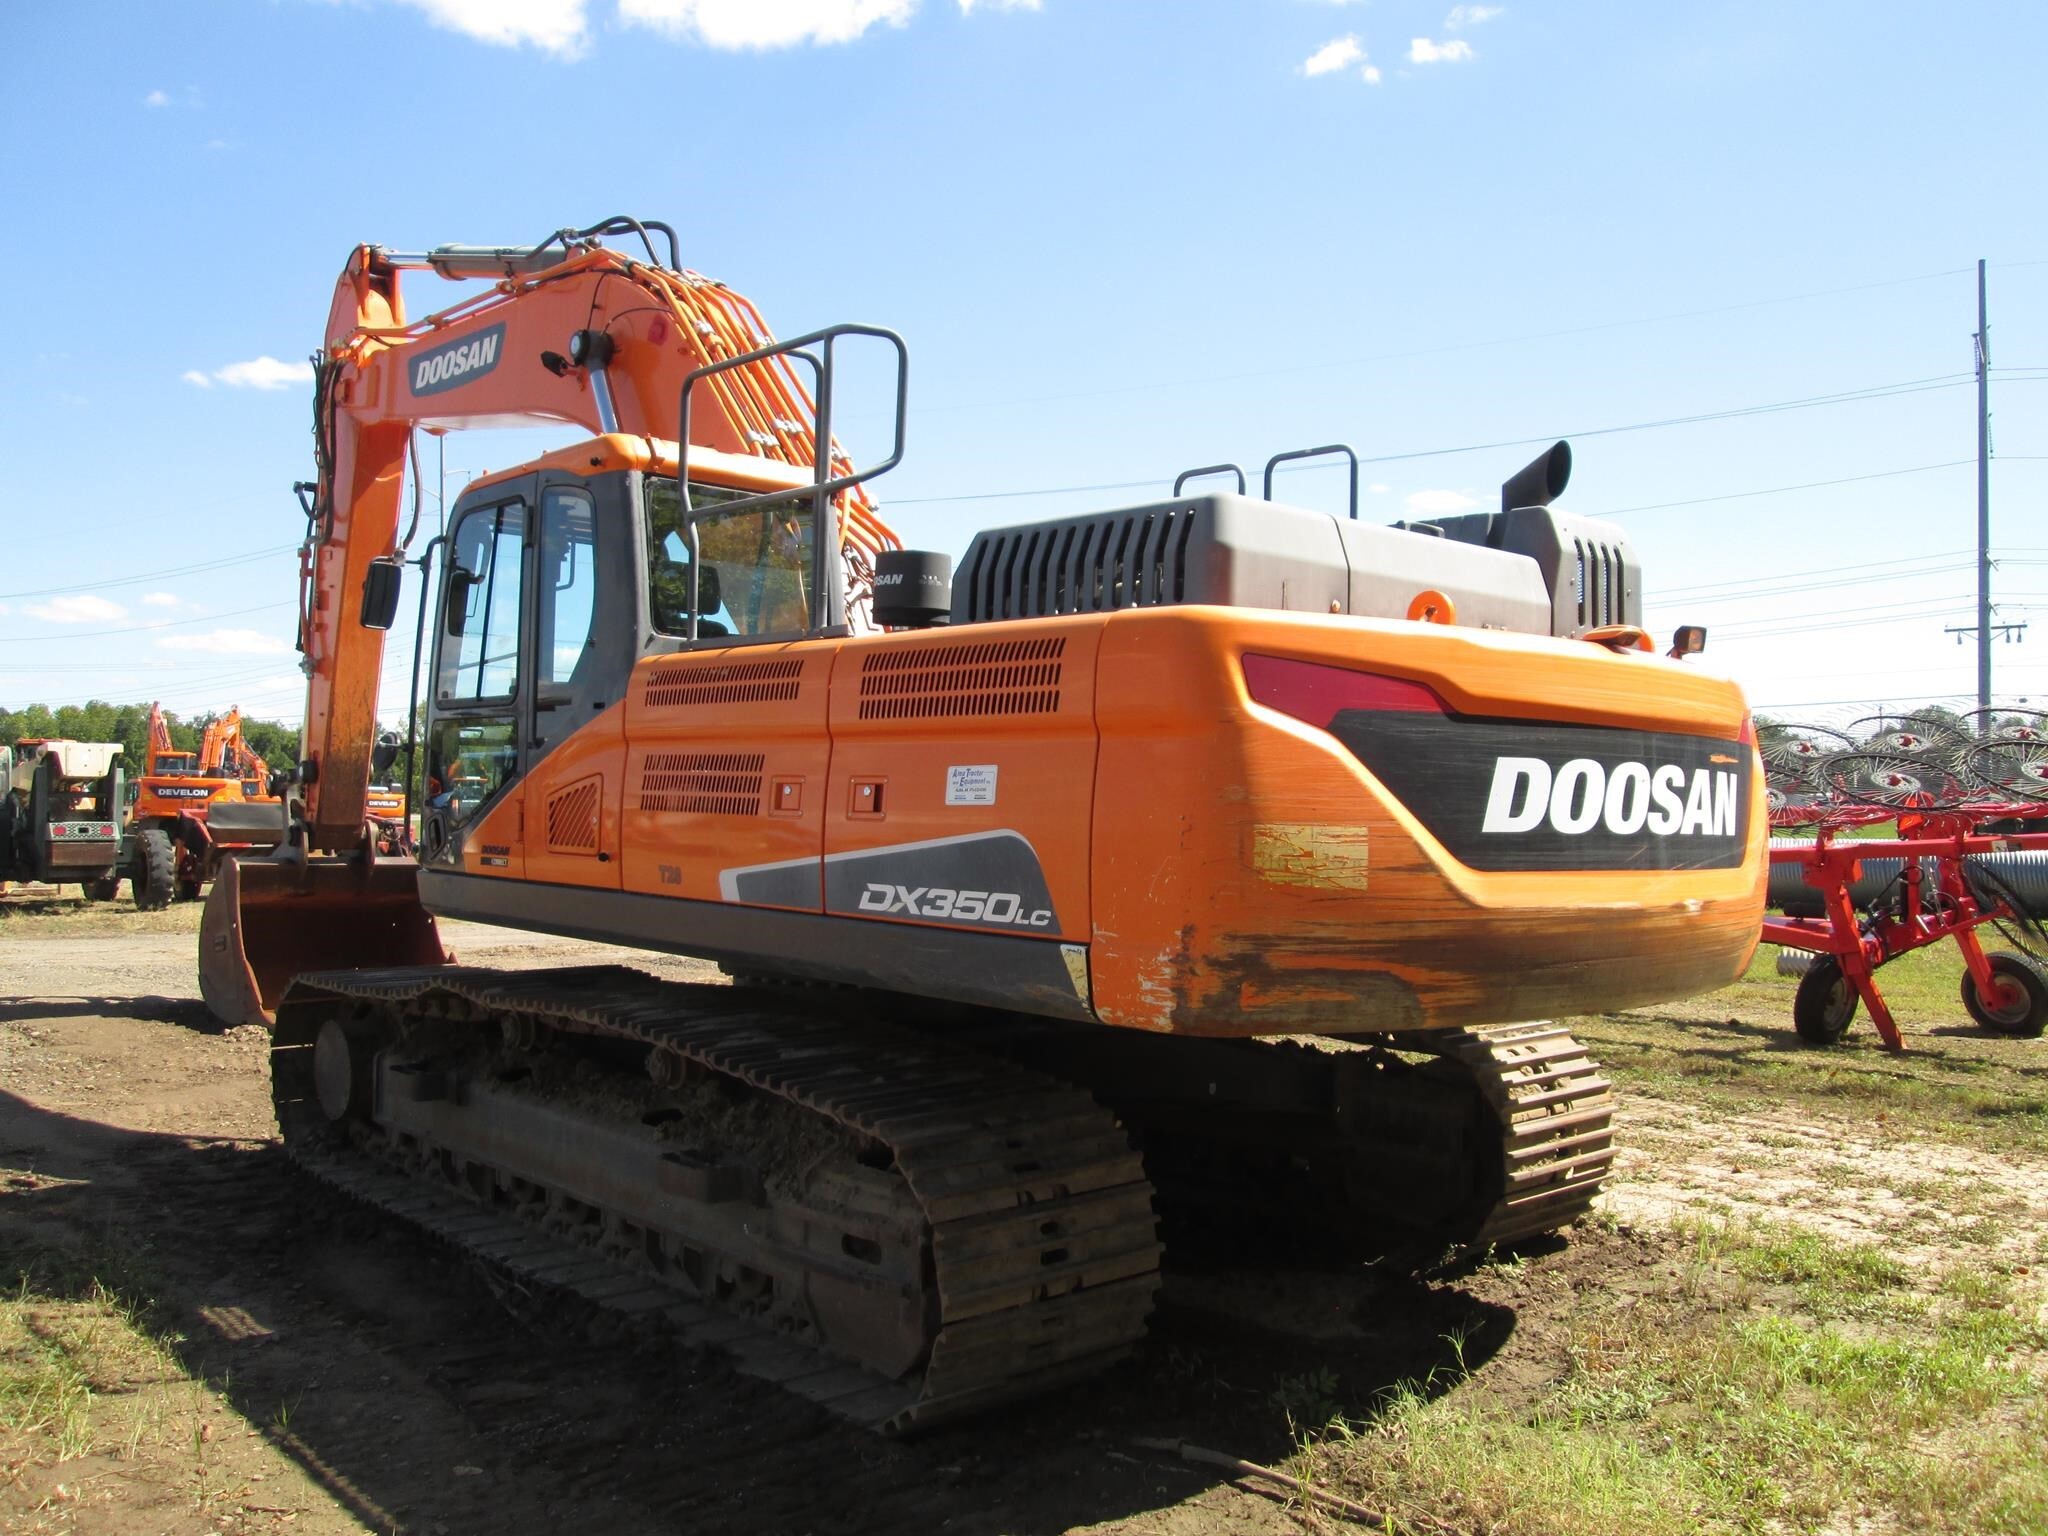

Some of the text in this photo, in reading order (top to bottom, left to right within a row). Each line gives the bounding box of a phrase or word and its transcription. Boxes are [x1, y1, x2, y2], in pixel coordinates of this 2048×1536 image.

[415, 333, 498, 390] DOOSAN
[158, 788, 208, 797] DEVELON
[959, 777, 986, 786] Equipment
[1481, 756, 1738, 836] DOOSAN
[858, 882, 1052, 926] DX350LC
